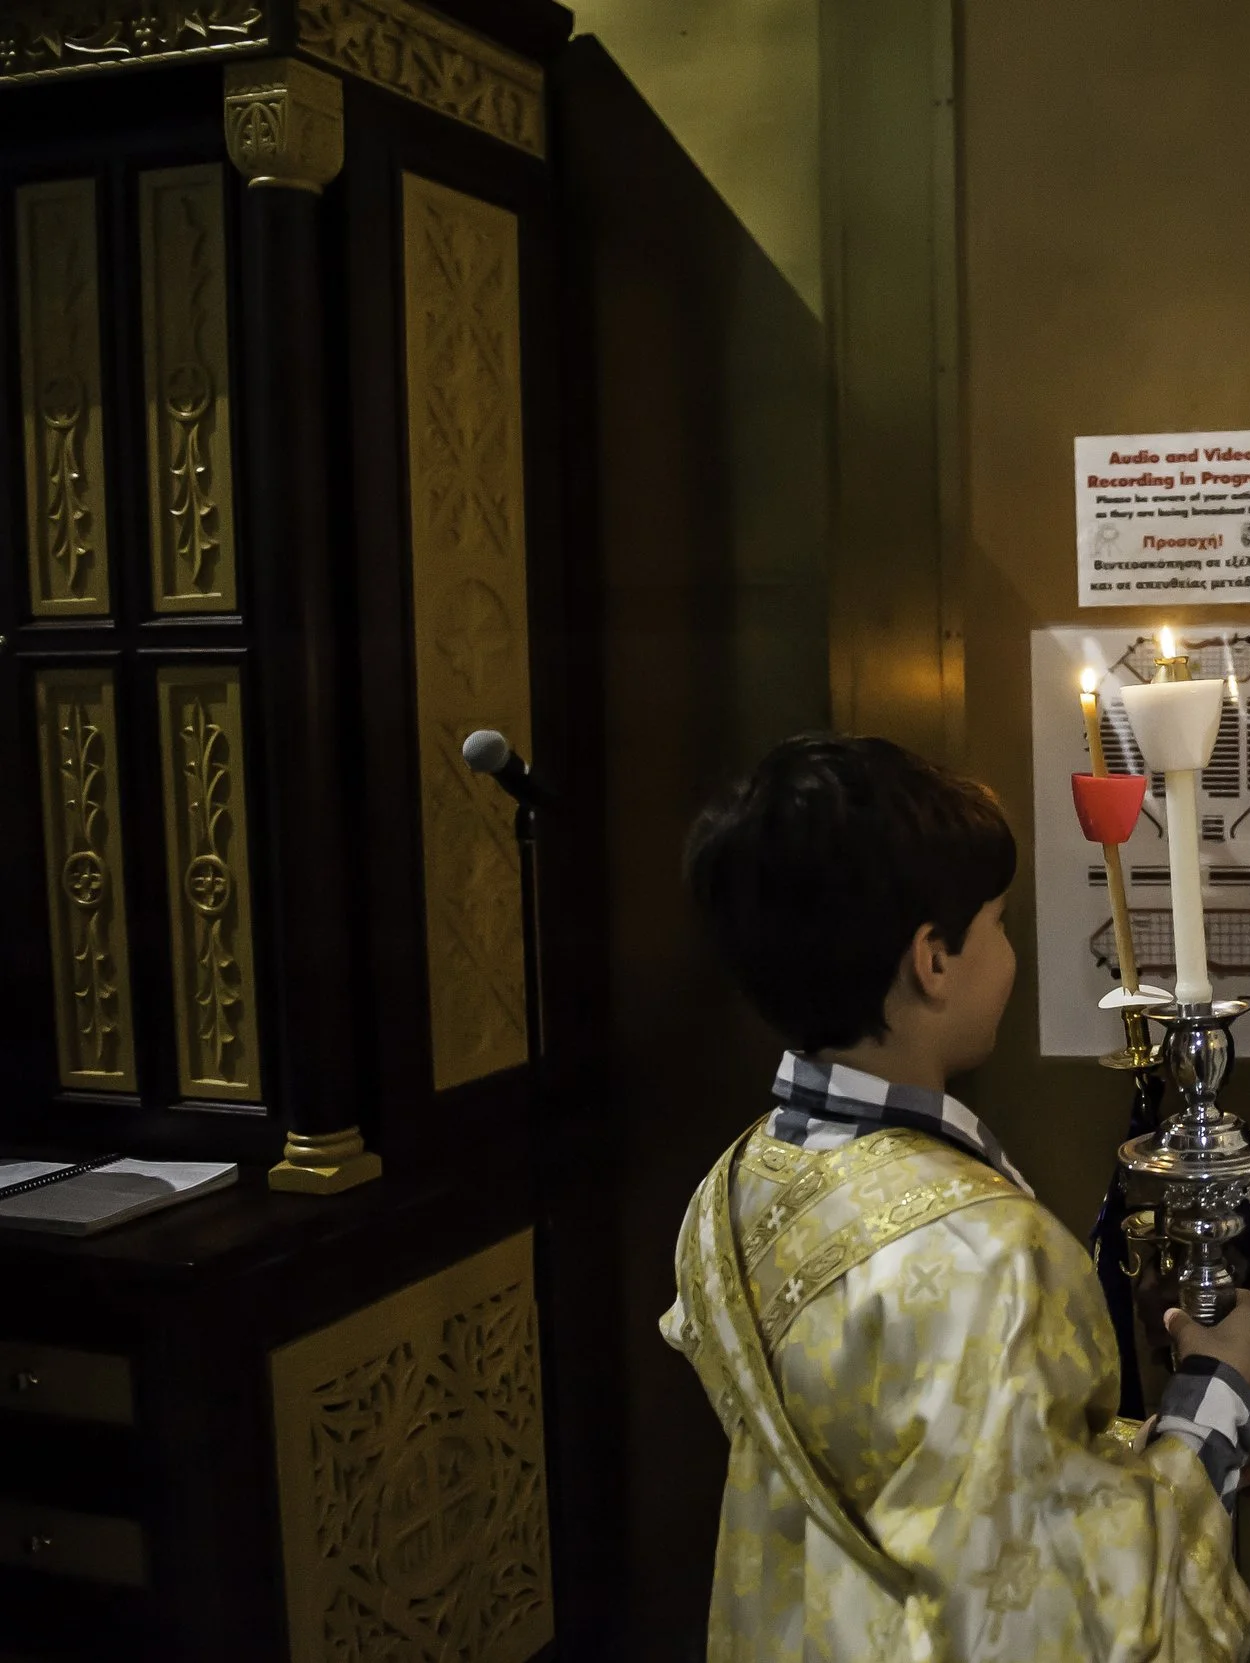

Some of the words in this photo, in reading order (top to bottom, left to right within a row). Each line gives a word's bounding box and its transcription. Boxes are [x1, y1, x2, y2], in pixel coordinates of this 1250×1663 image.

[1109, 450, 1160, 465] Audio
[1165, 448, 1199, 463] and
[1087, 472, 1175, 489] Recording
[1180, 472, 1196, 485] in
[1096, 494, 1132, 505] Please
[1135, 493, 1148, 504] be
[1152, 494, 1186, 503] aware
[1189, 491, 1200, 502] of
[1204, 493, 1228, 503] your
[1096, 511, 1107, 519] as
[1110, 509, 1134, 520] they
[1137, 510, 1155, 518] are
[1158, 507, 1189, 519] being
[1191, 506, 1246, 517] broadcast
[1143, 534, 1223, 551] Προσοχή!
[1206, 558, 1220, 569] σε
[1090, 582, 1113, 592] και
[1116, 581, 1131, 591] σε
[1136, 578, 1207, 590] απευθείας
